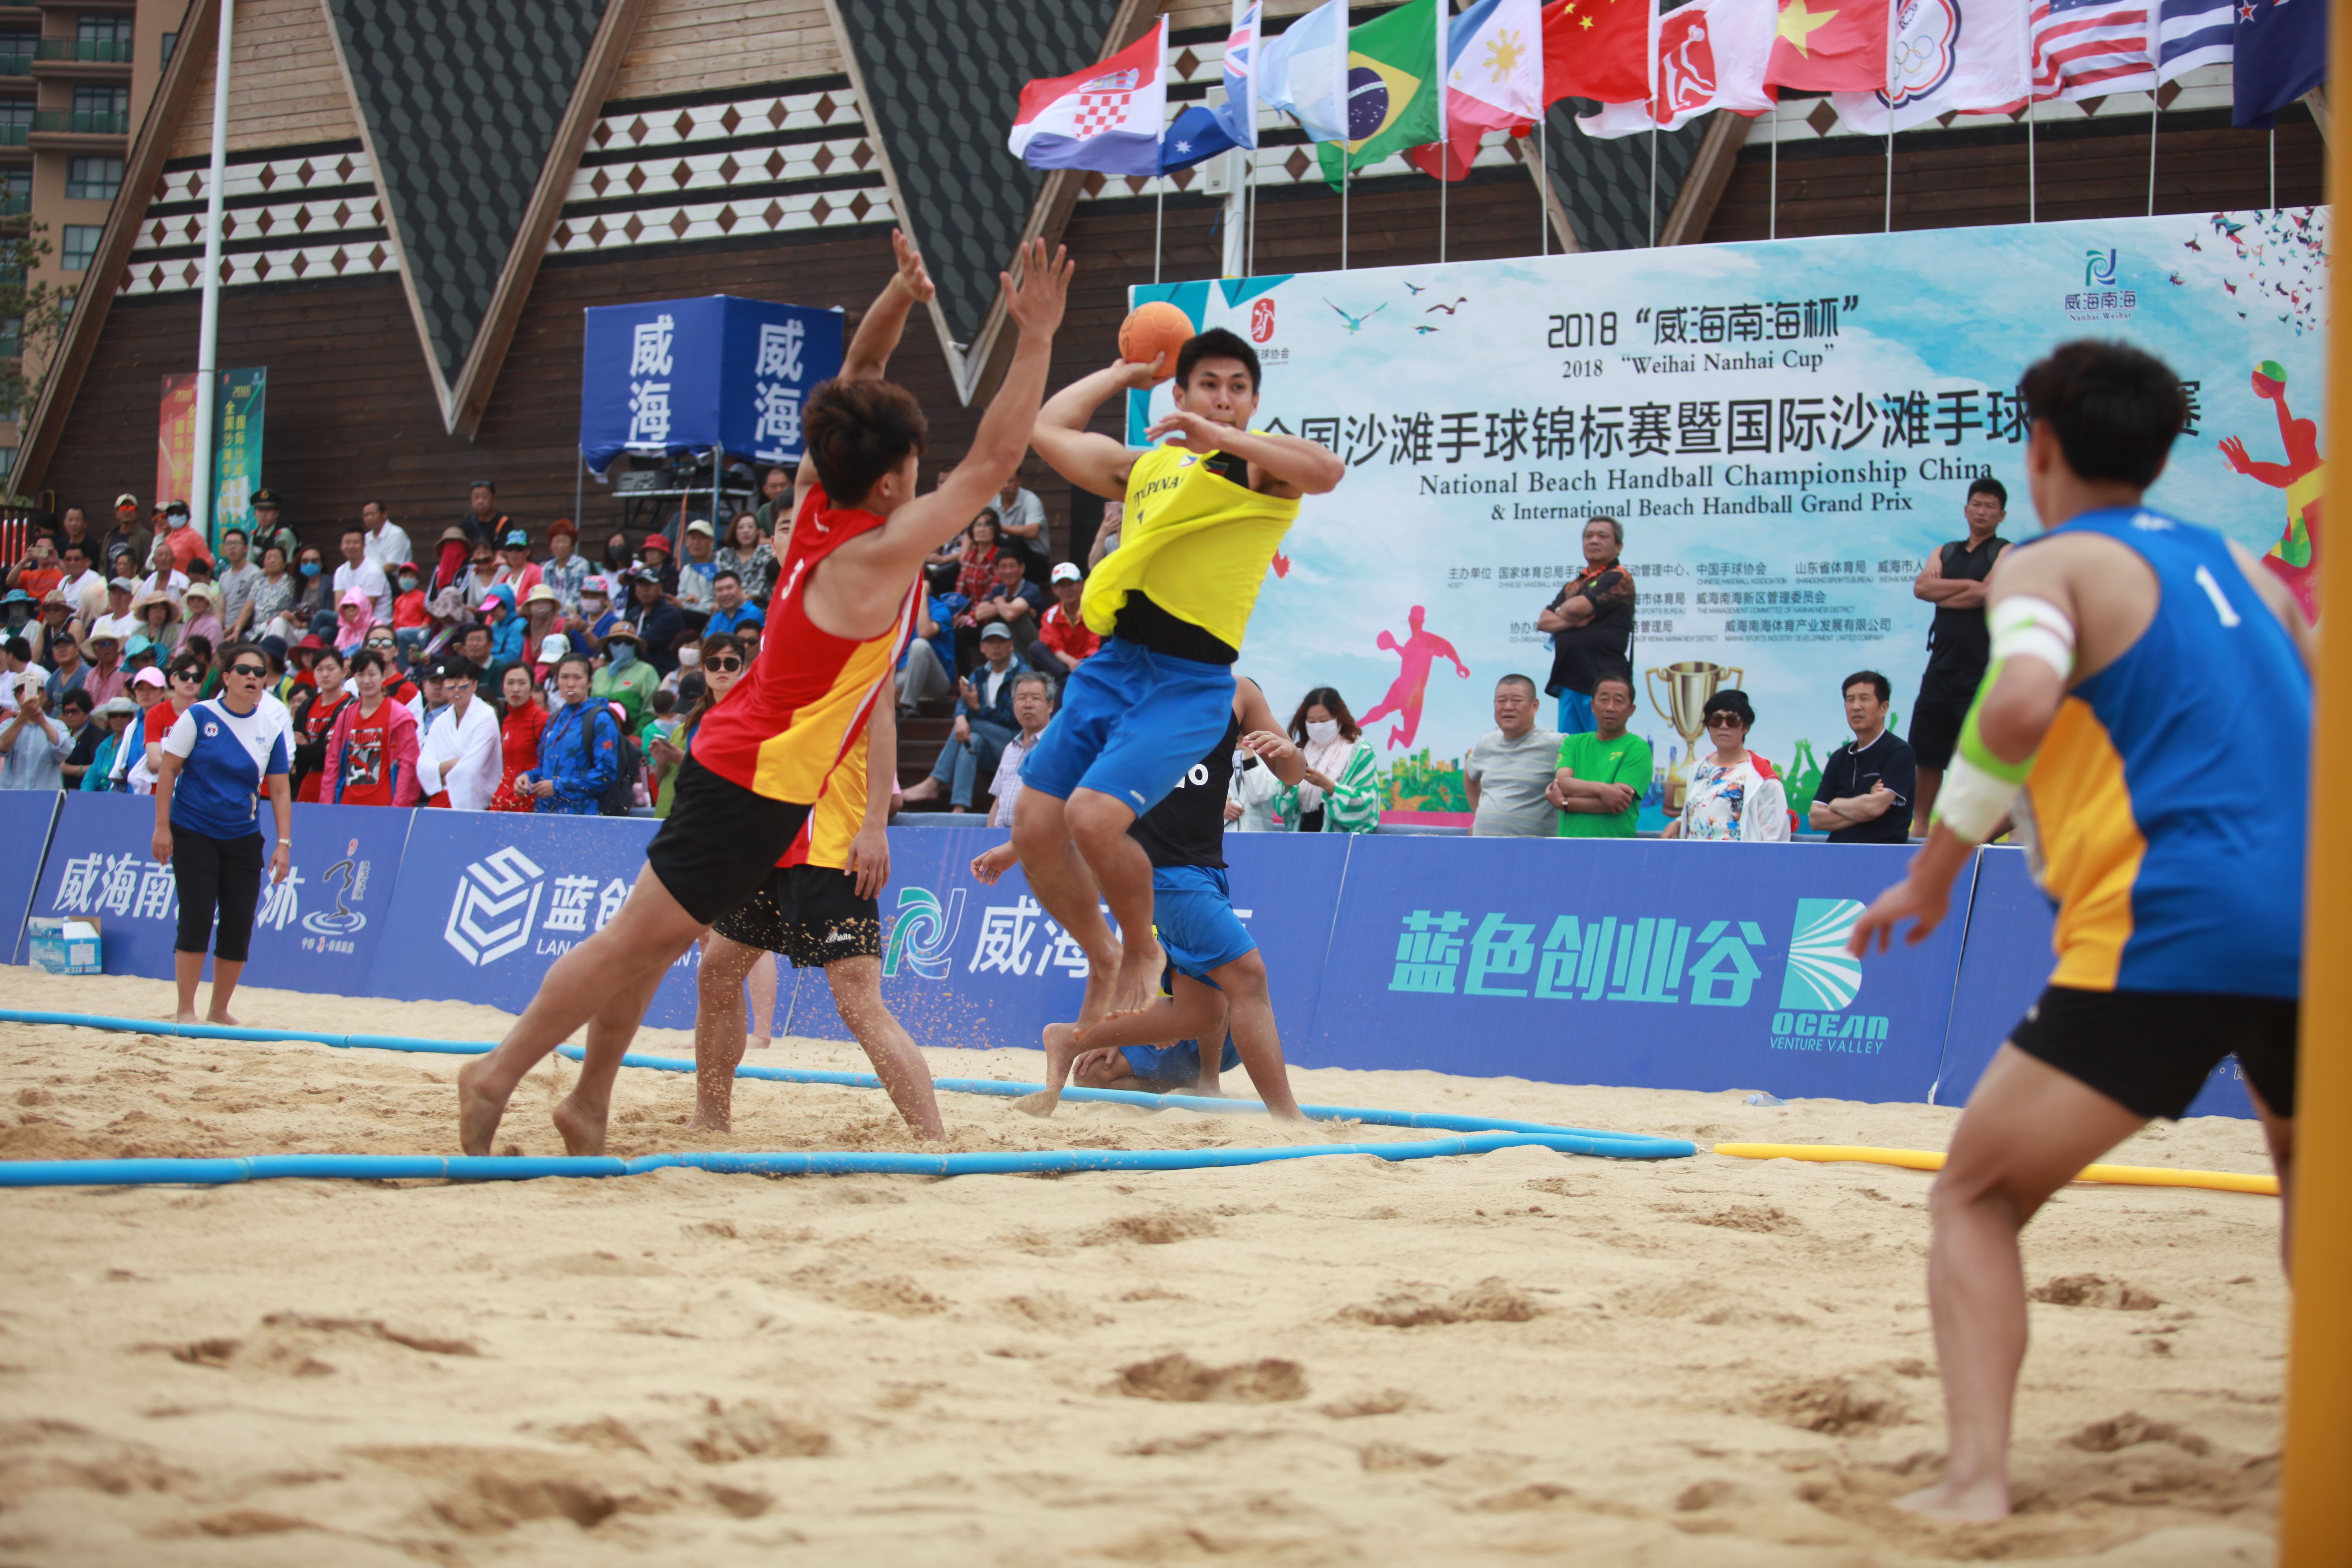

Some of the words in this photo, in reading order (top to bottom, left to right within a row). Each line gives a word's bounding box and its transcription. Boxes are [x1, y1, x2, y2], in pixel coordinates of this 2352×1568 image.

[2065, 290, 2135, 310] 威海南海
[1548, 312, 1617, 348] 2018
[1637, 296, 1858, 346] “威海南海杯”
[2070, 313, 2098, 322] Nanhai
[2102, 311, 2130, 320] Weihai
[1563, 359, 1603, 378] 2018
[1622, 355, 1695, 374] “Weihai
[1704, 351, 1774, 371] Nanhai
[1419, 472, 1517, 495] National
[1529, 469, 1597, 492] Beach
[1607, 465, 1713, 490] Handball
[1725, 461, 1907, 490] Championship
[1919, 457, 1992, 480] China
[1491, 505, 1505, 520] &
[1513, 500, 1631, 520] International
[1638, 498, 1694, 517] Beach
[1702, 495, 1792, 515] Handball
[1801, 493, 1863, 513] Grand
[1872, 492, 1912, 511] Prix
[1697, 562, 1767, 576] 中国手球协会
[1795, 560, 1866, 574] 山东省体育局
[1388, 910, 1767, 1006] 蓝色创业谷
[1770, 1037, 1823, 1051] VENTURE
[1828, 1039, 1883, 1054] VALLEY
